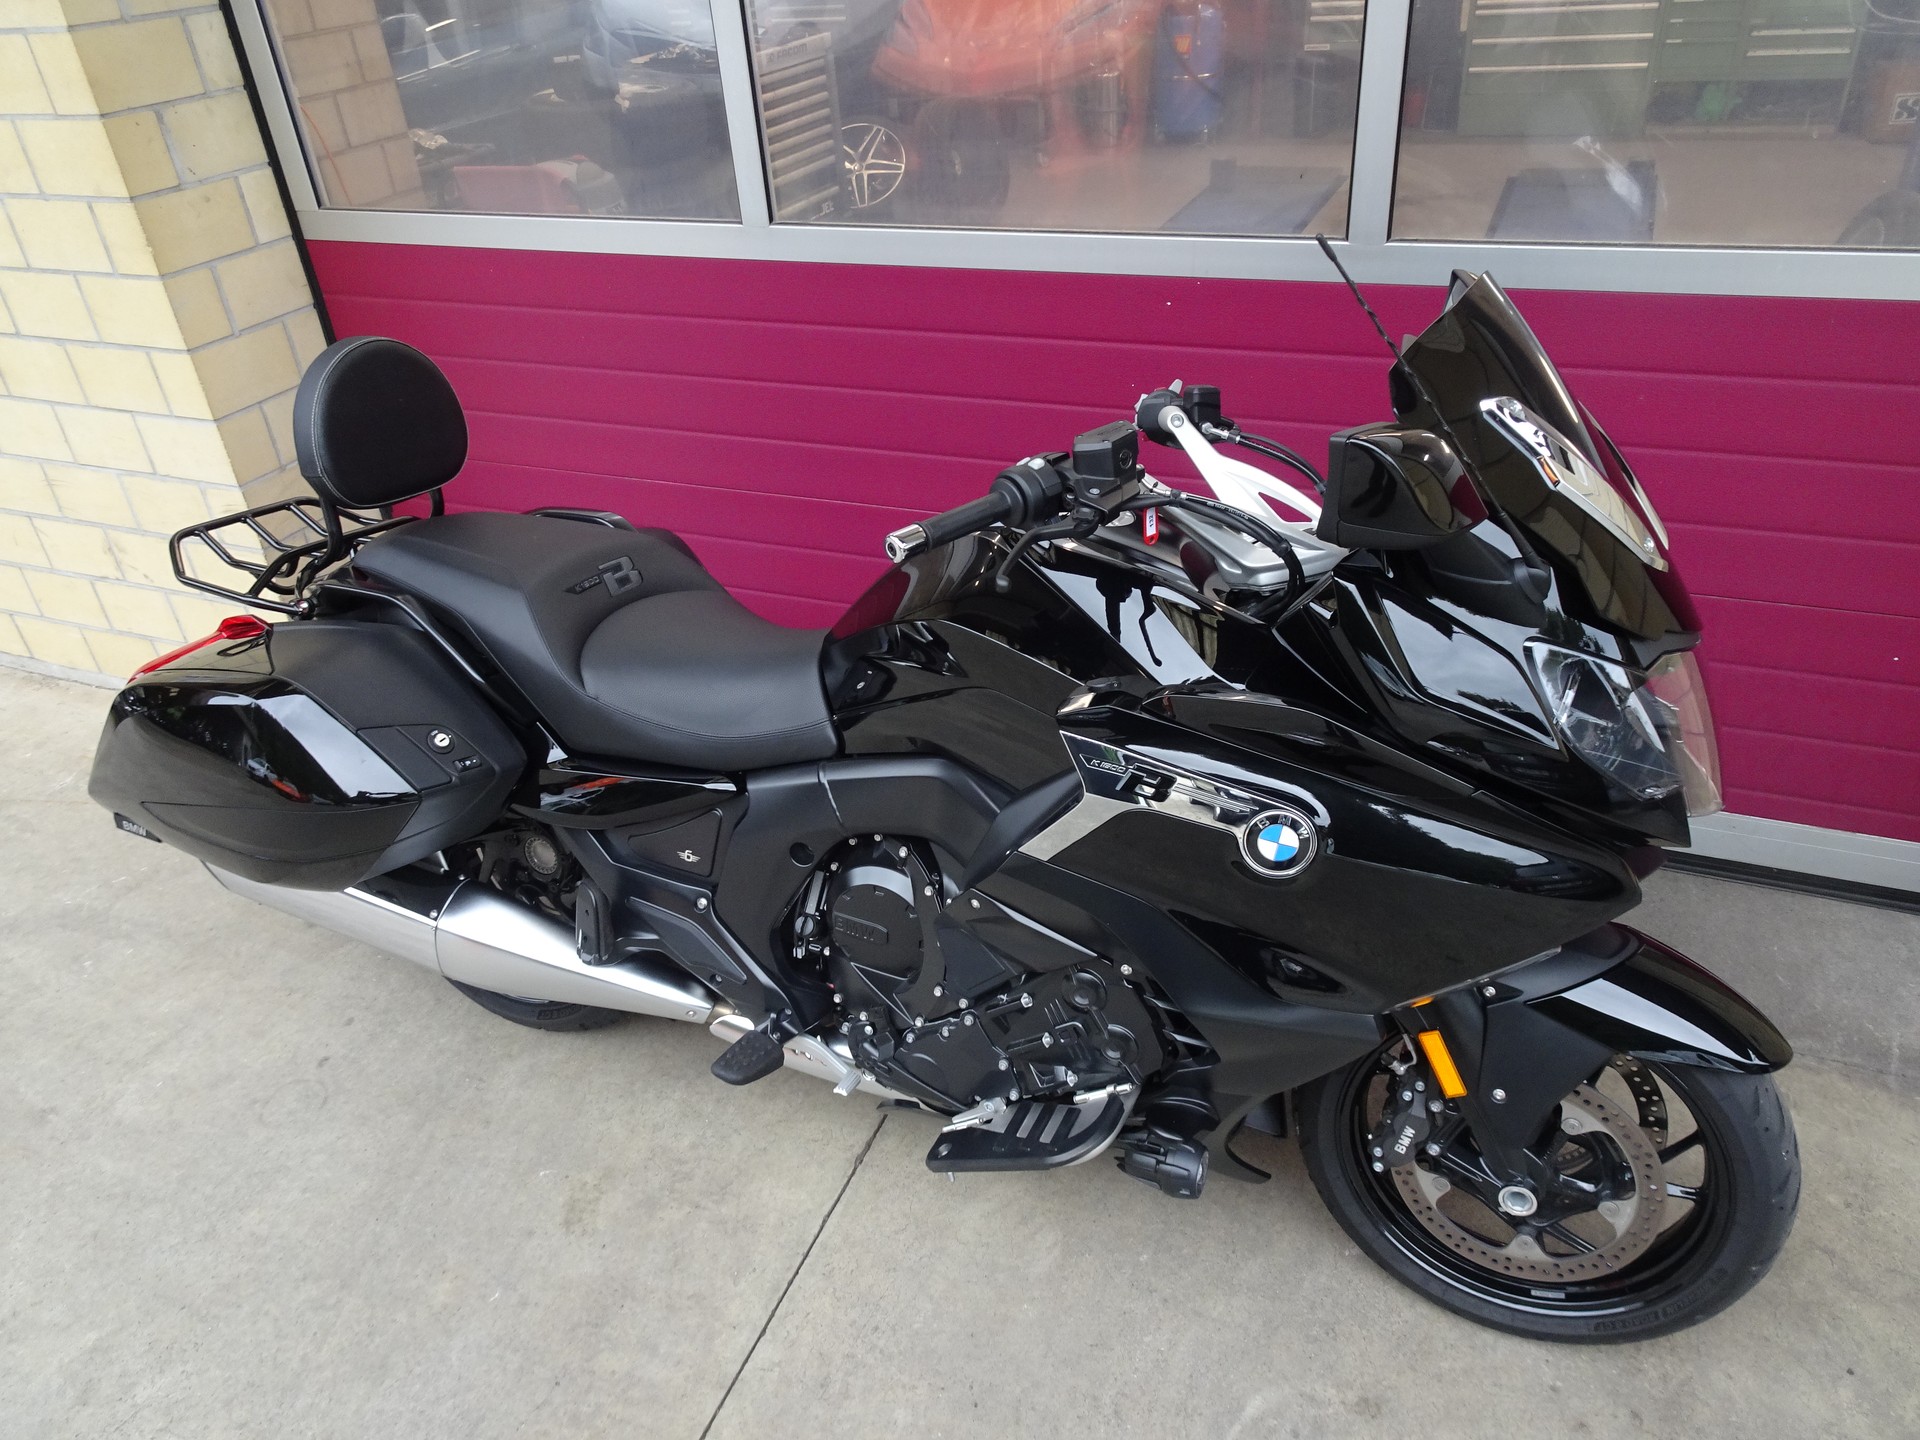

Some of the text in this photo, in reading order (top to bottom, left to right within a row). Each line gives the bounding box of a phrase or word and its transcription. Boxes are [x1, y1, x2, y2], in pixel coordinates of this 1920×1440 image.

[598, 556, 643, 597] B
[1115, 763, 1177, 802] B
[122, 820, 147, 837] BMW
[1256, 814, 1309, 839] BMW
[1394, 1125, 1416, 1155] BMW
